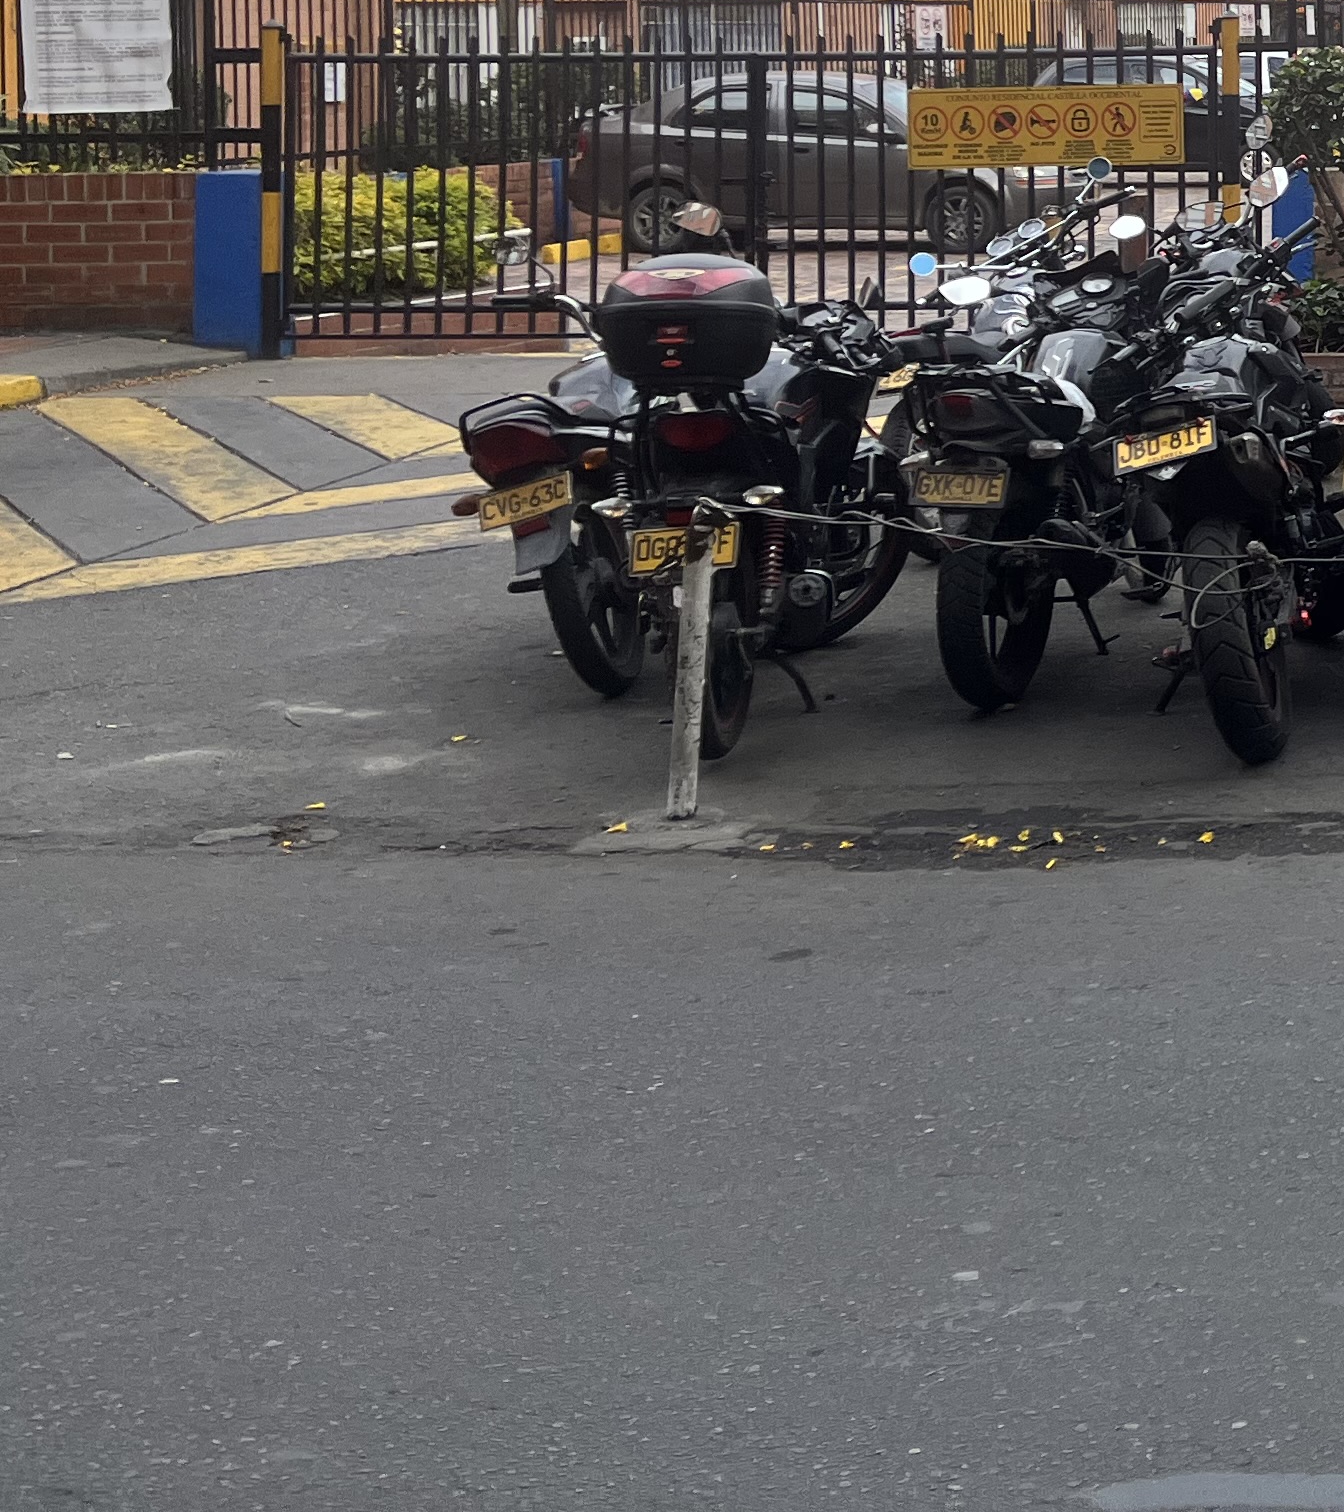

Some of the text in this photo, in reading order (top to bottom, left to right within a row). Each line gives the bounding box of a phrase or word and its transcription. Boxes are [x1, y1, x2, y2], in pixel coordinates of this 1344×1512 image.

[946, 91, 1143, 102] CONJUNTO RESIDENCIAL CASTILLA OCCIDENTAL
[922, 114, 939, 127] 10
